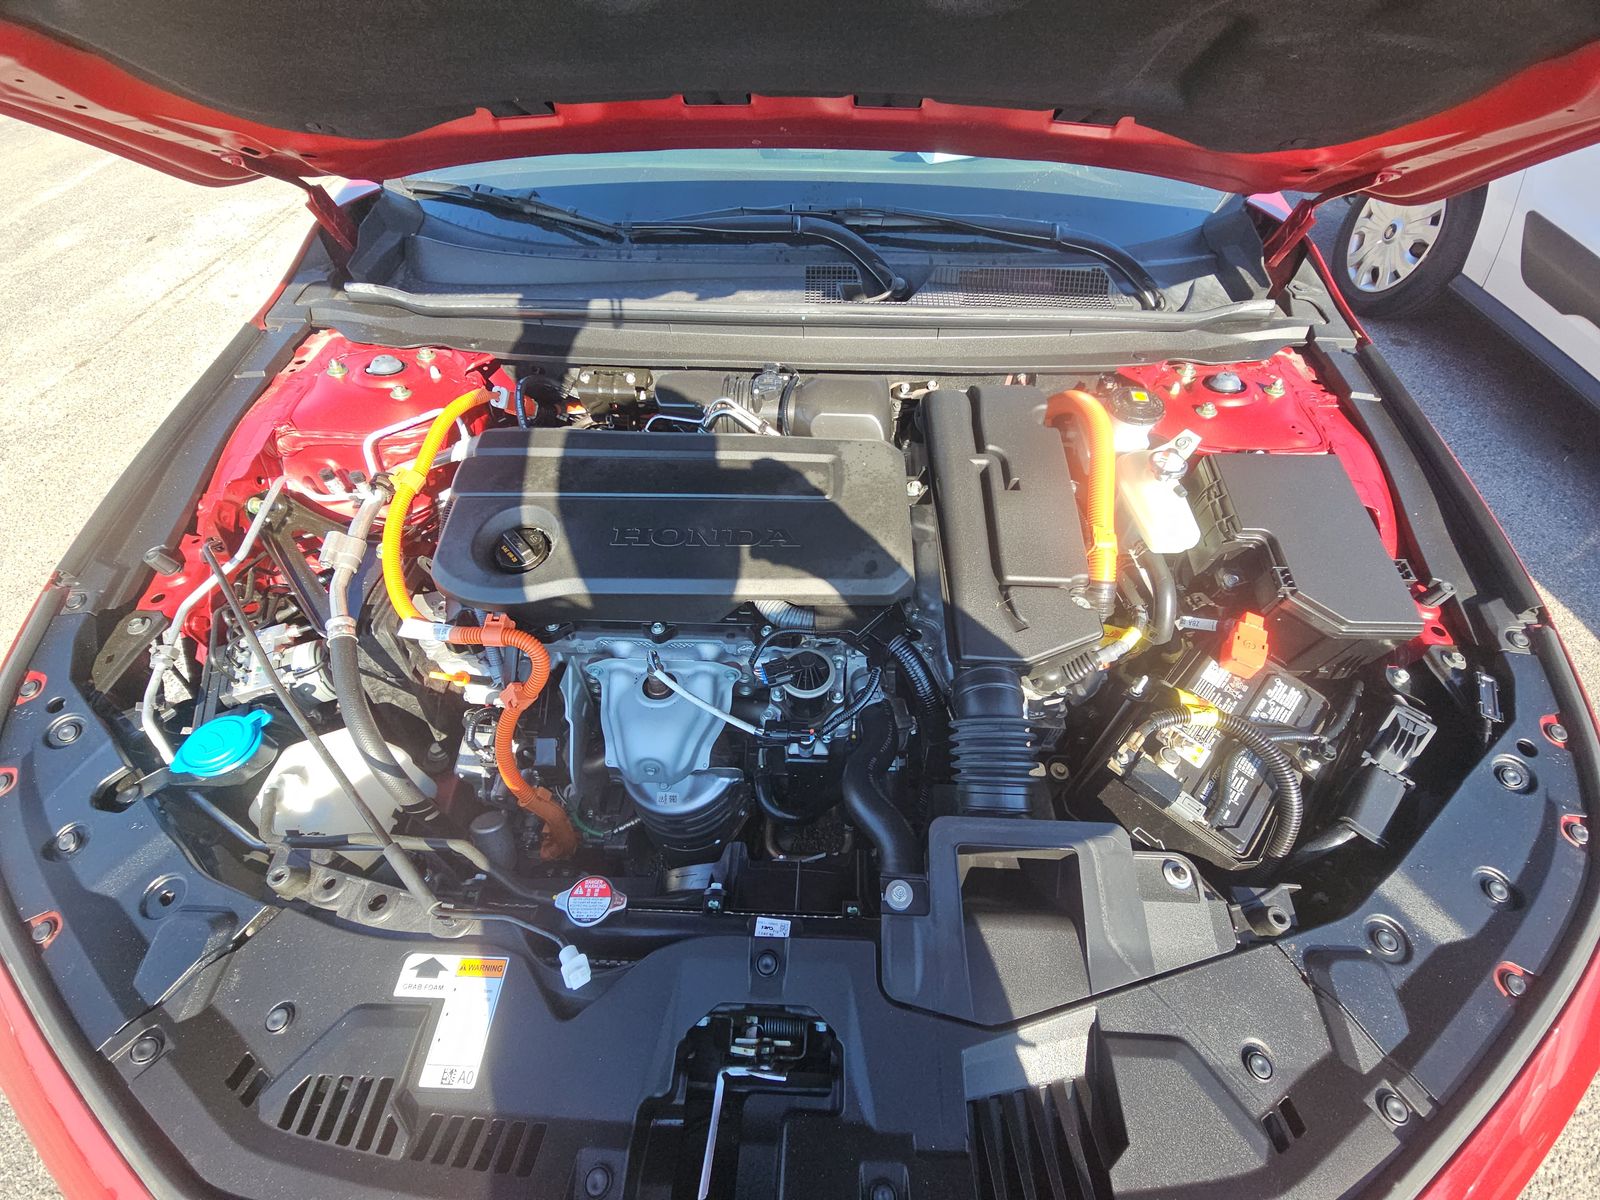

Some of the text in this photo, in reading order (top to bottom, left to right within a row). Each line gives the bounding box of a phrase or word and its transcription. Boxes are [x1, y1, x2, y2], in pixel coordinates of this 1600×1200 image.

[609, 527, 801, 547] HONDA
[468, 964, 503, 973] WARNING
[402, 983, 423, 991] GRAB
